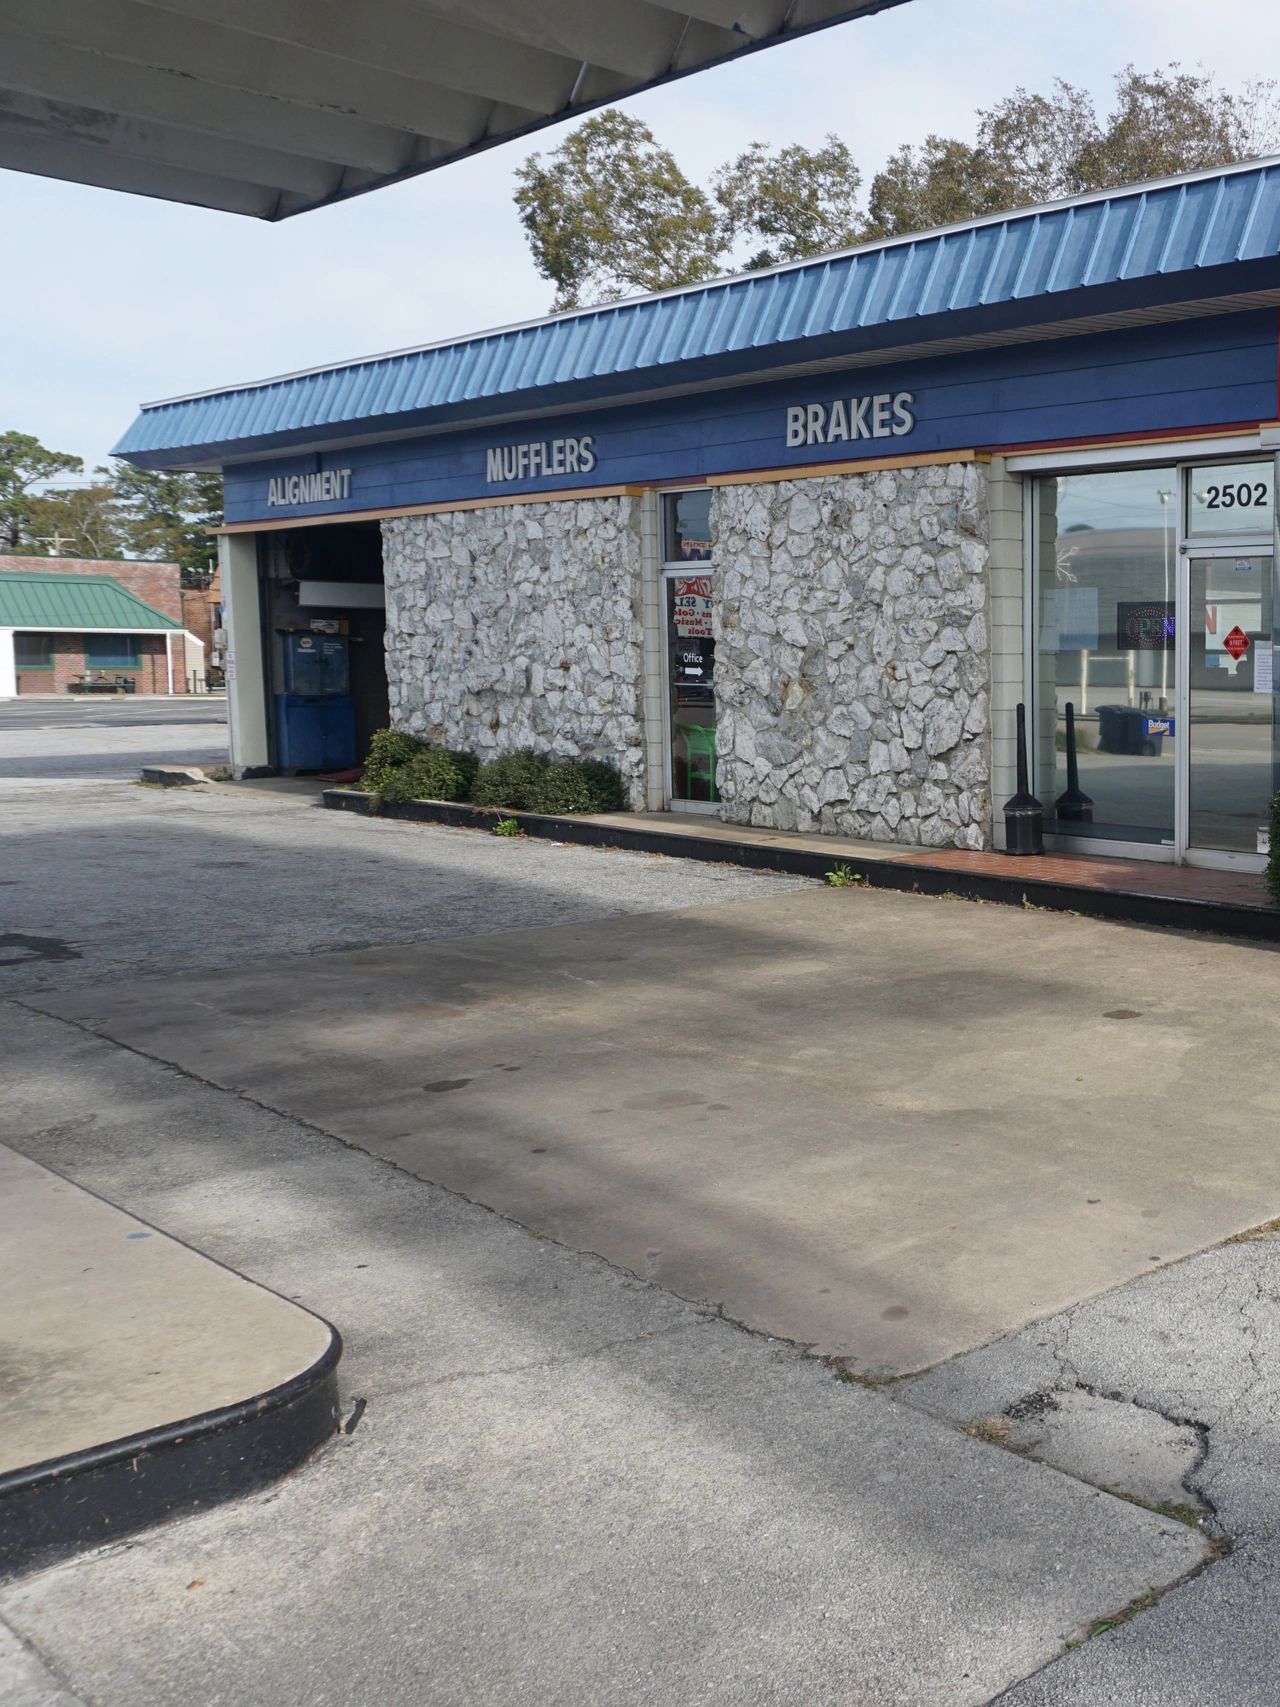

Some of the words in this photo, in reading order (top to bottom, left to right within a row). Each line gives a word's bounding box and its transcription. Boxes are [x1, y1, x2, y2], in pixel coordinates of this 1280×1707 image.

[786, 392, 914, 448] BRAKES
[486, 437, 595, 483] MUFFLERS
[267, 469, 352, 507] ALIGNMENT
[1207, 482, 1267, 509] 2502
[683, 652, 703, 662] Office
[1148, 719, 1169, 729] Budget
